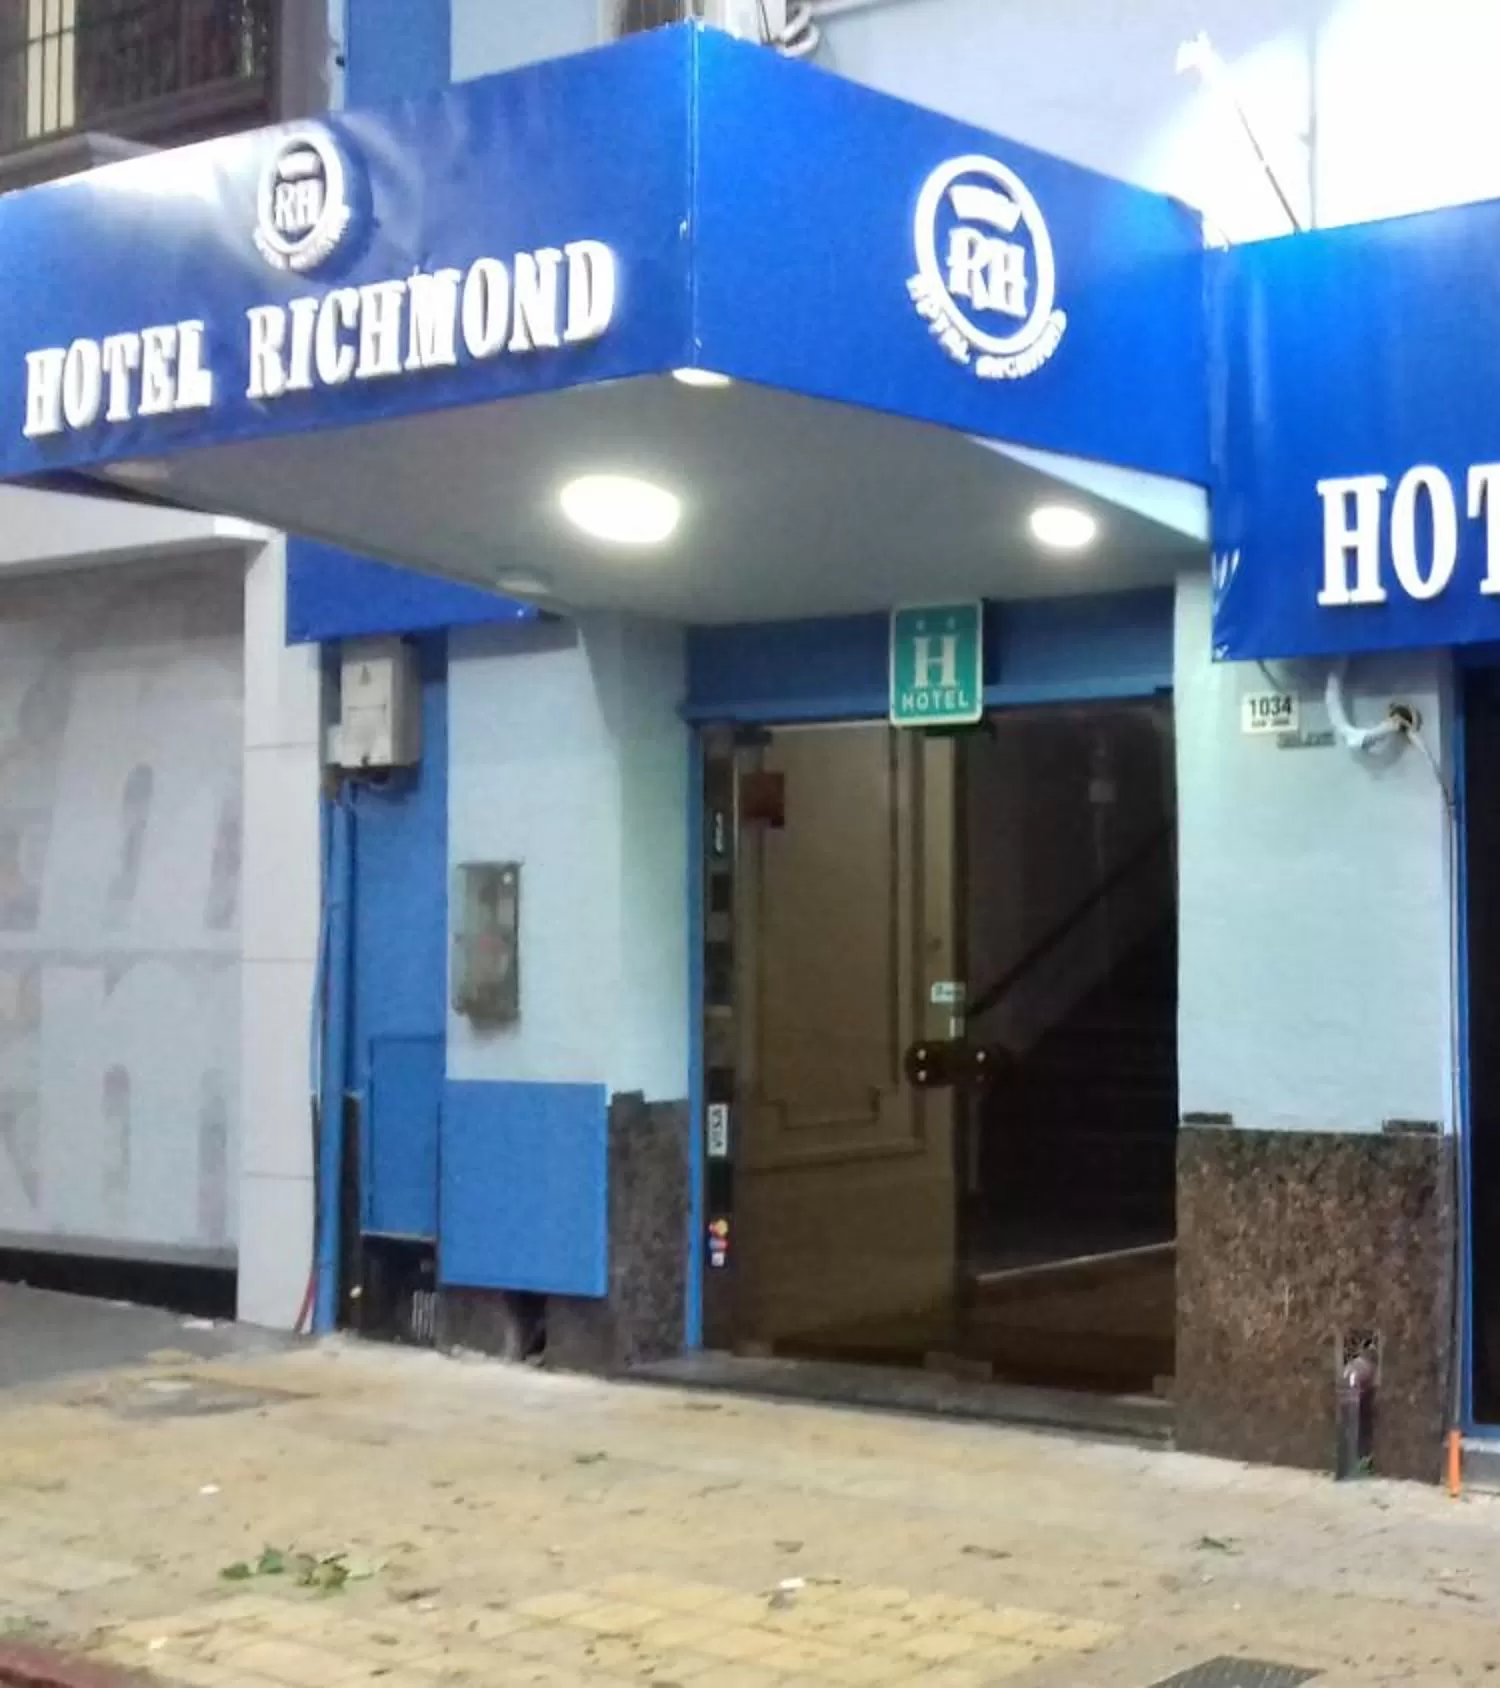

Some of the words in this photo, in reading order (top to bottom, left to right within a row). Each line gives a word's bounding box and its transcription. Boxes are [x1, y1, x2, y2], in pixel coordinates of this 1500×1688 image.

[946, 226, 1028, 319] RH
[23, 318, 213, 438] HOTEL
[246, 238, 617, 399] RICHMOND
[901, 689, 969, 712] HOTEL
[1248, 695, 1292, 717] 1034
